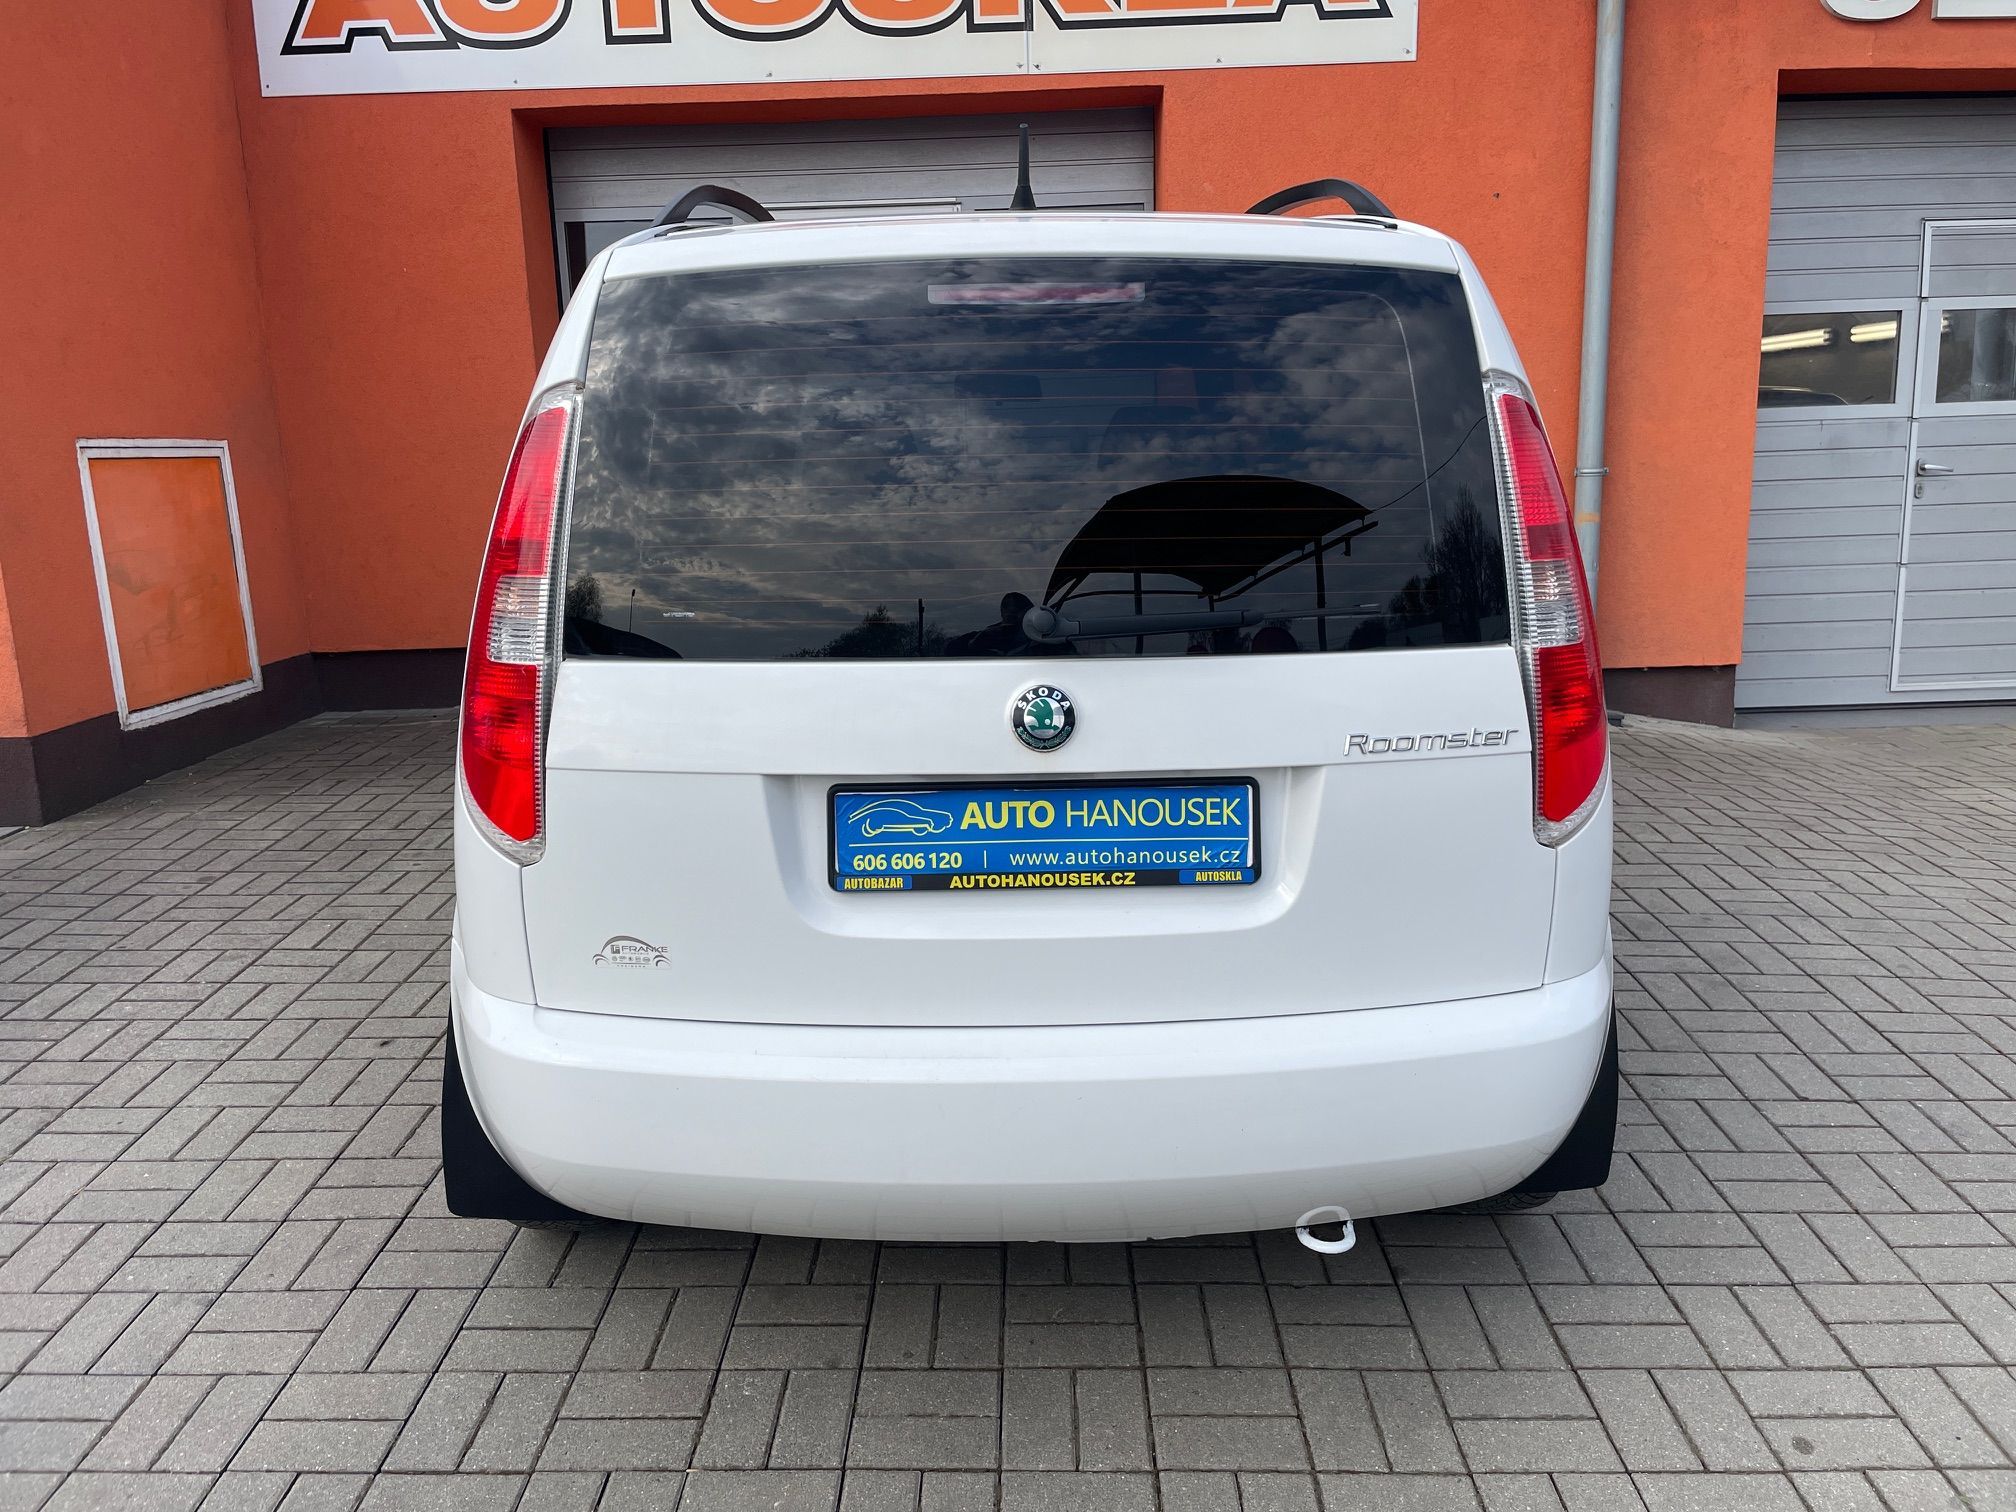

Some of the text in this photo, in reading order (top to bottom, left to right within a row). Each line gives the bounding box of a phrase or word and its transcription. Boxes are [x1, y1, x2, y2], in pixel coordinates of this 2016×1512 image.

[1343, 727, 1519, 756] Roomster
[960, 798, 1242, 830] AUTO HANOUSEK
[853, 846, 1241, 871] 606 606 120 www.autohanousek.cz
[844, 877, 904, 890] AUTOBAZAR
[949, 872, 1136, 889] AUTOHANOUSEK.CZ
[1195, 870, 1242, 882] AUTOSKLA
[621, 945, 668, 953] FRANKE
